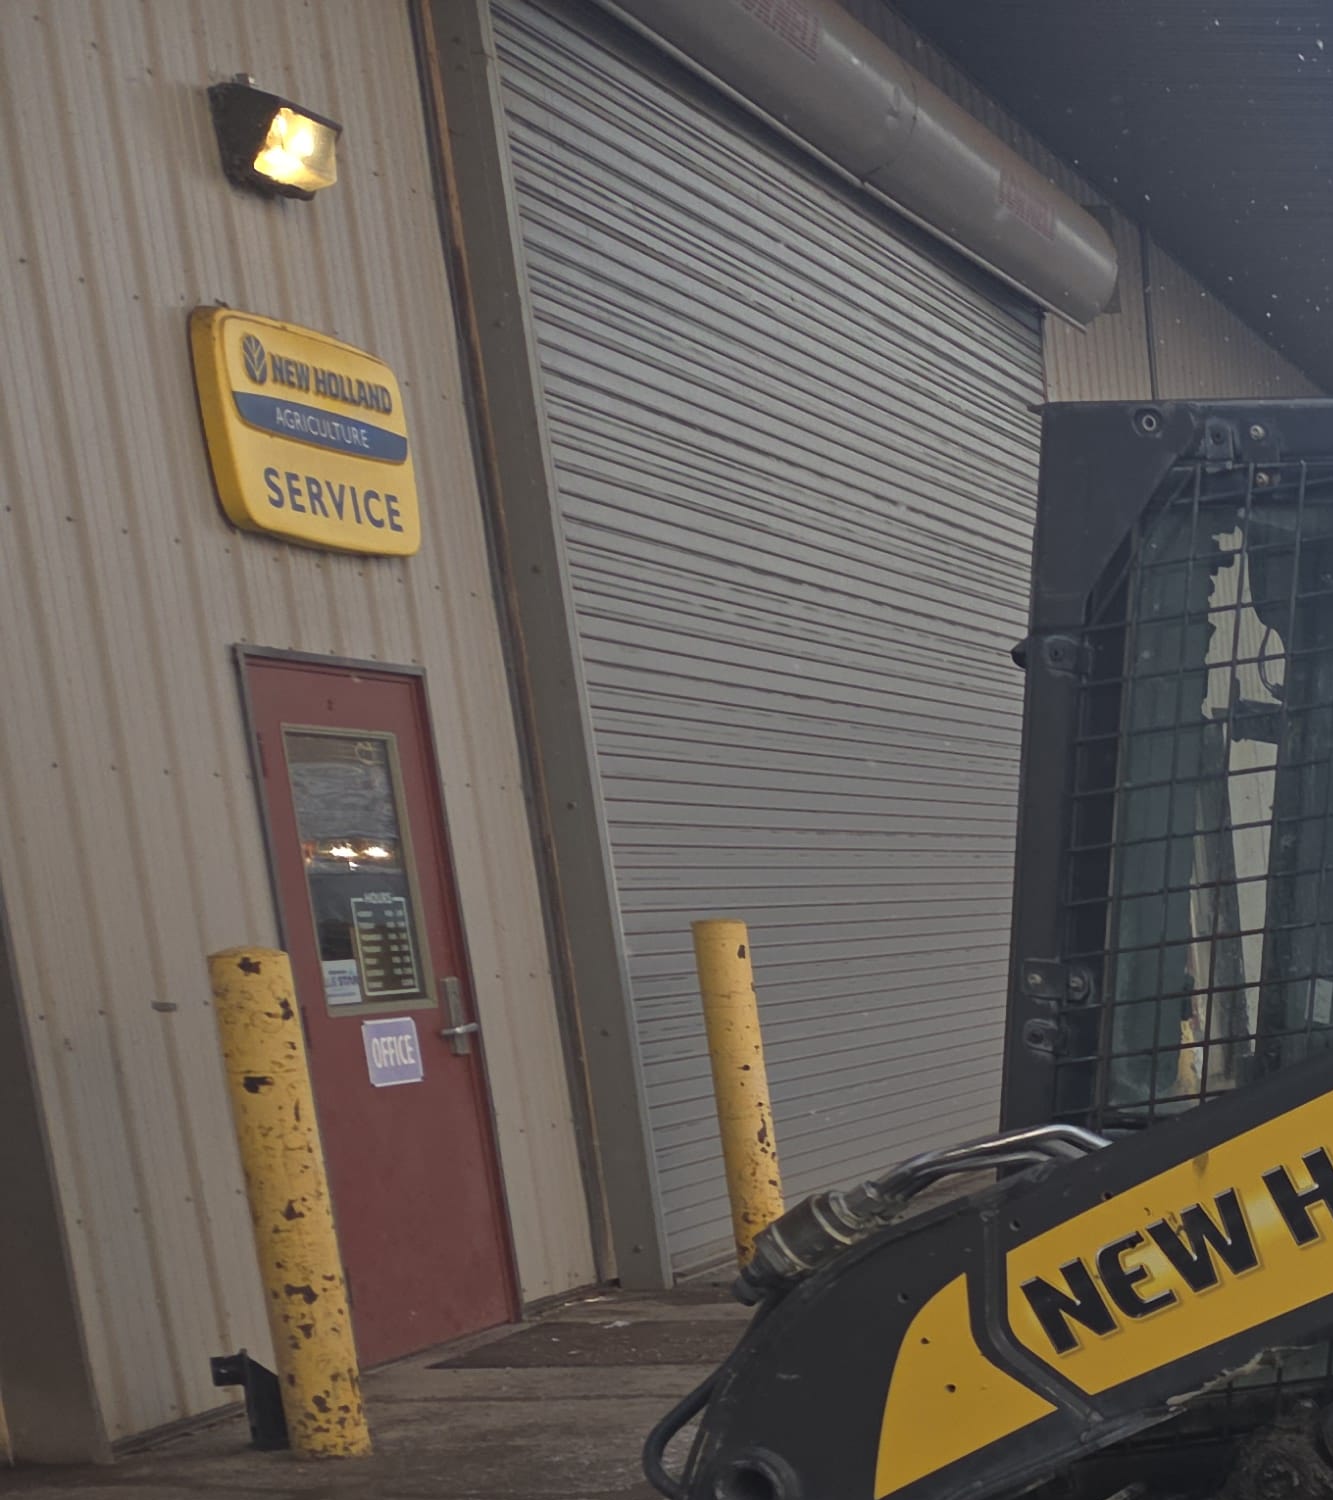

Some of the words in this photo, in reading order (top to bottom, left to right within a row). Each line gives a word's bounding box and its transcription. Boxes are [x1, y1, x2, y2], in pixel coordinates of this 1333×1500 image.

[270, 352, 310, 394] NEW
[312, 366, 393, 417] HOLLAND
[275, 407, 370, 449] AGRICULTURE
[263, 466, 404, 533] SERVICE
[371, 1034, 417, 1069] OFFICE
[1019, 1187, 1261, 1356] NEW
